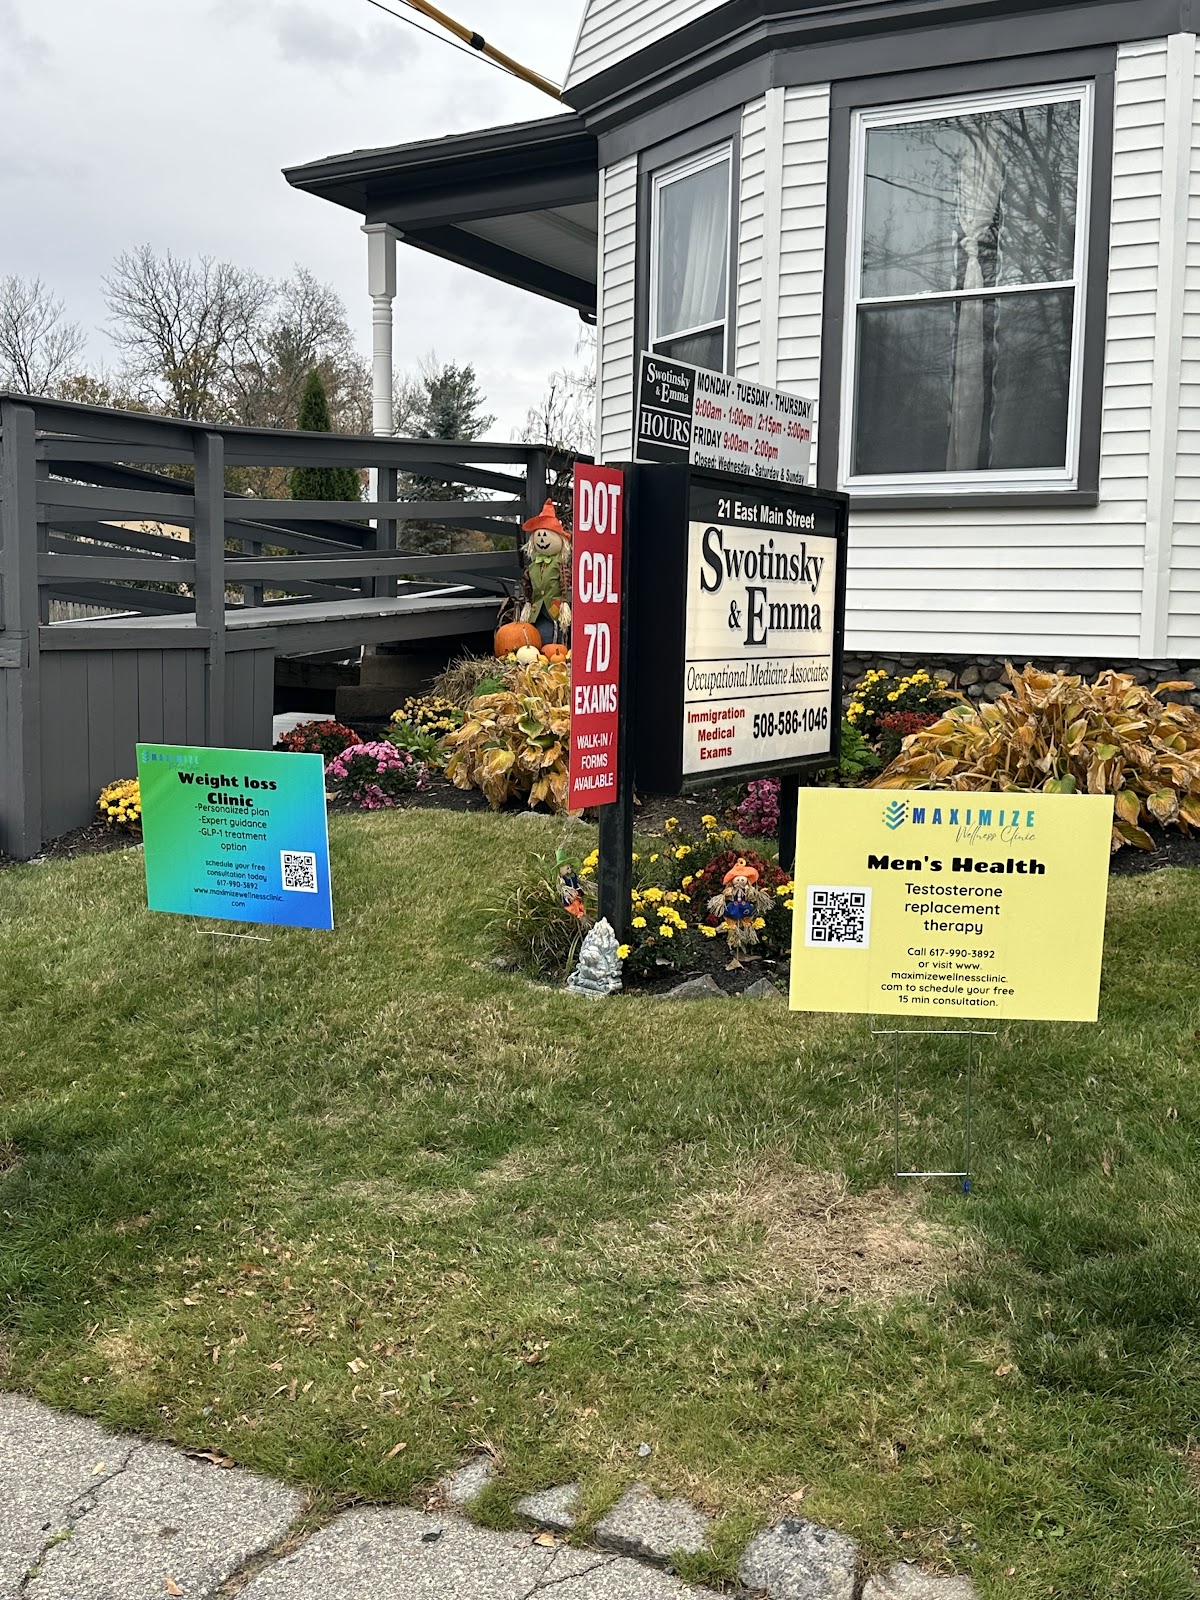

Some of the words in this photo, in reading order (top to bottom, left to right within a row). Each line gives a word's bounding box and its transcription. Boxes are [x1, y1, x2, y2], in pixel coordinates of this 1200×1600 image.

[646, 363, 691, 390] Swotinsky
[655, 387, 661, 396] &
[660, 383, 689, 403] Emma
[697, 372, 731, 397] MONDAY
[737, 383, 770, 408] TUESDAY
[775, 394, 811, 418] THURSDAY
[640, 411, 690, 444] HOURS
[695, 398, 722, 420] 9:00am
[728, 406, 753, 430] 1:00pm
[758, 414, 782, 435] 2:15pm
[787, 421, 810, 443] 5:00pm
[693, 426, 722, 448] FRIDAY
[723, 432, 749, 453] 9:00am
[754, 439, 779, 462] 2:00pm
[694, 451, 716, 468] Closed:
[718, 455, 750, 475] Wednesday
[755, 465, 779, 482] Saturday
[786, 471, 805, 484] Sunday
[579, 479, 621, 535] DOT
[718, 499, 730, 518] 21
[734, 501, 758, 522] East
[760, 506, 784, 525] Main
[786, 509, 815, 529] Street
[700, 526, 824, 593] Swotinsky
[578, 551, 618, 604] CDL
[728, 600, 741, 629] &
[743, 586, 822, 646] Emma
[584, 622, 611, 673] 7D
[687, 663, 748, 695] Occupational
[749, 662, 787, 687] Medicine
[788, 663, 829, 684] Associates
[574, 683, 618, 715] EXAMS
[687, 708, 745, 725] Immigration
[753, 707, 828, 739] 508-586-1046
[576, 733, 609, 750] WALK-IN
[698, 725, 735, 742] Medical
[581, 752, 608, 769] FORMS
[700, 746, 732, 760] Exams
[178, 772, 239, 789] Weight
[245, 776, 277, 790] loss
[573, 768, 613, 791] AVAILABLE
[207, 792, 254, 807] Clinic
[251, 808, 269, 817] plan
[912, 807, 1035, 828] MAXIMIZE
[230, 819, 267, 829] guidance
[956, 820, 997, 845] Wellness
[1000, 825, 1036, 846] Clinic
[225, 830, 267, 840] treatment
[221, 842, 246, 852] option
[205, 859, 233, 868] schedule
[235, 863, 249, 871] your
[252, 863, 266, 871] free
[867, 854, 942, 872] Men's
[952, 857, 1046, 875] Health
[207, 869, 246, 879] consultation
[248, 872, 267, 882] today
[905, 883, 1003, 897] Testosterone
[905, 901, 1000, 916] replacement
[923, 919, 983, 935] therapy
[907, 947, 926, 956] Call
[929, 948, 995, 958] 617-990-3892
[932, 960, 953, 970] visit
[956, 962, 982, 970] www.
[891, 970, 1008, 983] maximizewellnessclinic.
[881, 983, 903, 991] com
[906, 983, 916, 992] to
[919, 983, 964, 994] schedule
[967, 986, 990, 996] your
[993, 986, 1015, 995] free
[898, 995, 908, 1003] 15
[911, 996, 930, 1004] min
[932, 996, 998, 1007] consultation.
